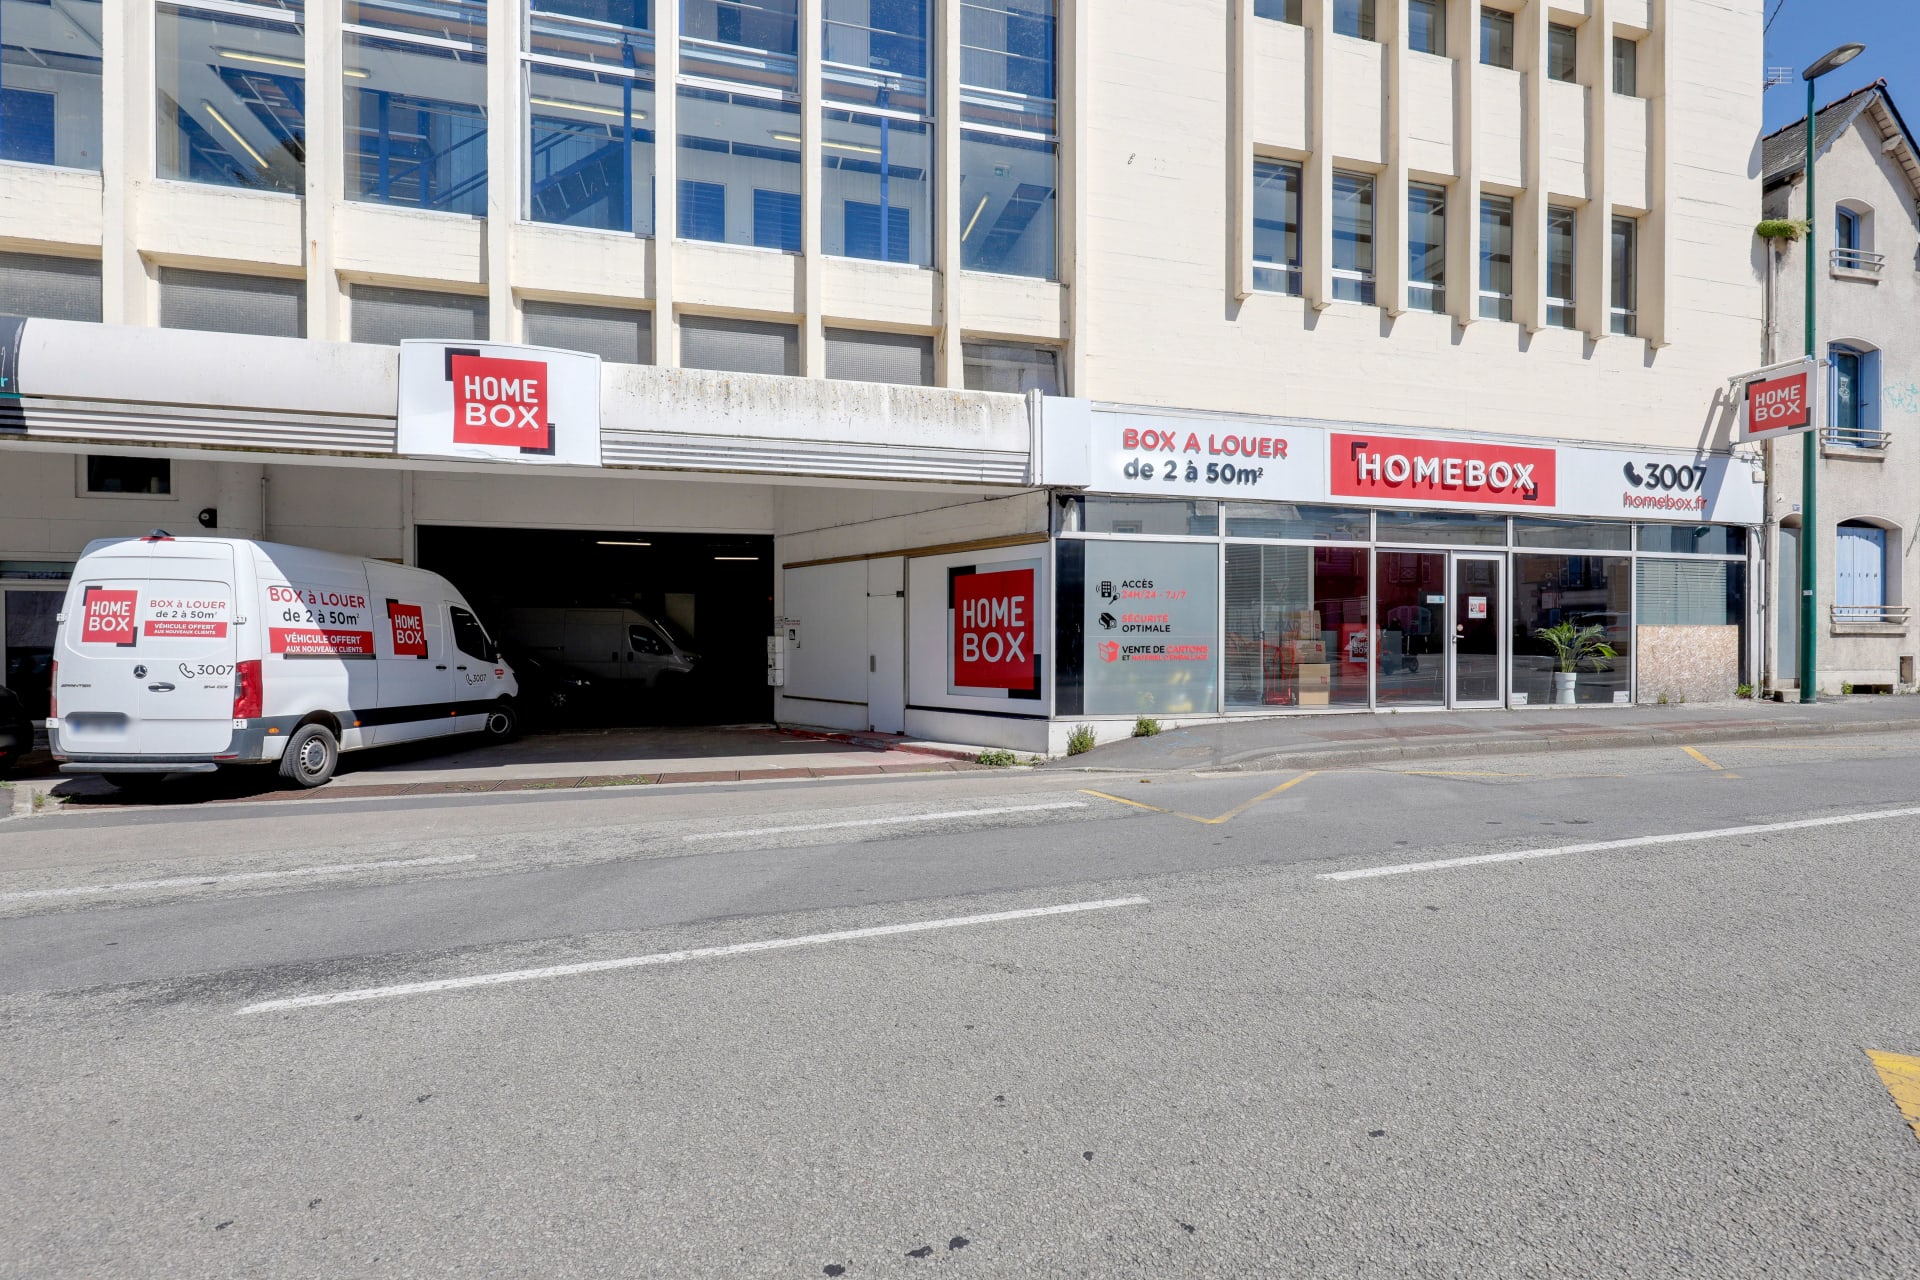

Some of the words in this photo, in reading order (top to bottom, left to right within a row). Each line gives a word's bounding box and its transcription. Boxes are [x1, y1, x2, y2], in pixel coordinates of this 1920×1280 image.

[464, 375, 539, 404] HOME
[1755, 384, 1801, 407] HOME
[465, 402, 539, 430] BOX
[1755, 400, 1801, 422] BOX
[1123, 428, 1176, 452] BOX
[1183, 432, 1201, 453] A
[1209, 434, 1288, 459] LOUER
[1123, 457, 1154, 480] de
[1163, 460, 1177, 481] 2
[1185, 460, 1198, 482] à
[1206, 462, 1264, 485] 50m²
[1357, 452, 1535, 490] HOMEBOX
[1645, 463, 1707, 491] 3007
[1623, 492, 1707, 511] homebox.fr
[1121, 579, 1154, 589] ACCÈS
[269, 587, 303, 602] BOX
[308, 591, 316, 605] à
[320, 592, 366, 609] LOUER
[1121, 590, 1157, 600] 24H/24
[90, 601, 132, 616] HOME
[150, 600, 173, 608] BOX
[177, 600, 182, 608] à
[186, 601, 226, 609] LOUER
[962, 595, 1025, 629] HOME
[156, 610, 169, 618] de
[181, 610, 187, 618] à
[282, 608, 300, 622] de
[306, 610, 314, 623] 2
[318, 609, 326, 624] à
[394, 614, 421, 630] HOME
[89, 617, 129, 632] BOX
[1121, 624, 1171, 633] OPTIMALE
[284, 632, 329, 643] VÉHICULE
[396, 630, 423, 645] BOX
[285, 645, 301, 653] AUX
[302, 645, 338, 653] NOUVEAUX
[962, 631, 1026, 663] BOX
[1122, 645, 1151, 653] VENTE
[1153, 645, 1165, 653] DE
[196, 664, 234, 675] 3007
